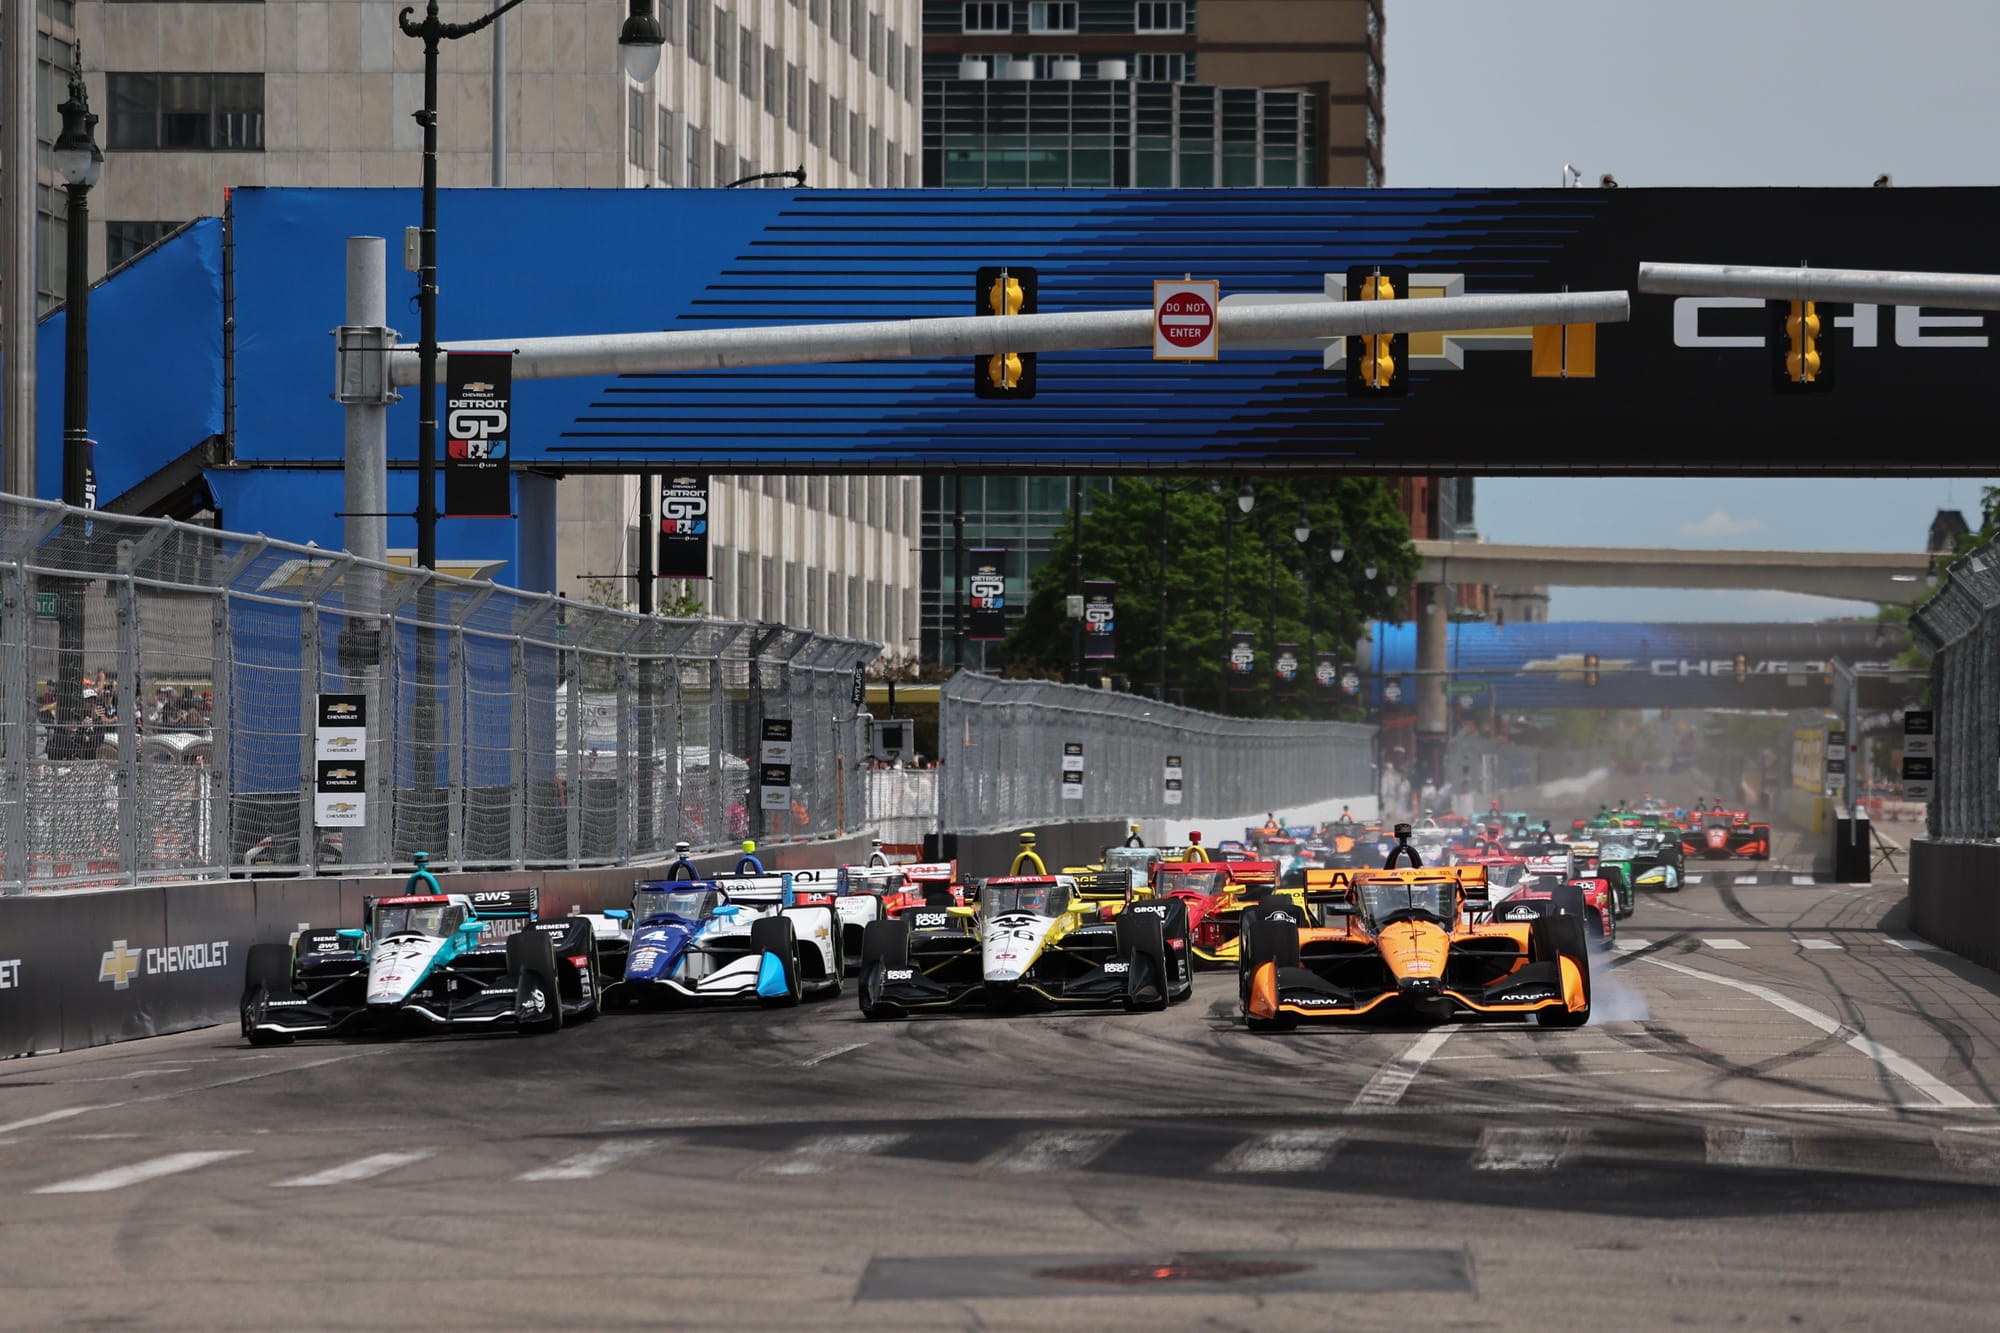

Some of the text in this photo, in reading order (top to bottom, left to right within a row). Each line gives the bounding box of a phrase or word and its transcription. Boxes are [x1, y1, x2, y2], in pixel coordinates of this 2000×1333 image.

[1166, 303, 1206, 312] DO NOT
[1170, 328, 1201, 337] ENTER
[449, 400, 508, 408] DETROIT
[448, 409, 508, 439] GP
[662, 497, 707, 519] GP
[971, 581, 1004, 598] GP
[1086, 608, 1114, 622] GP
[1231, 653, 1254, 664] GP
[996, 876, 1043, 884] ANDRETTI
[388, 896, 435, 904] ANDRETTI
[474, 891, 510, 902] aws
[640, 930, 669, 941] 4
[988, 930, 1034, 943] 26
[146, 941, 229, 975] CHEVROLET
[375, 951, 422, 964] 27
